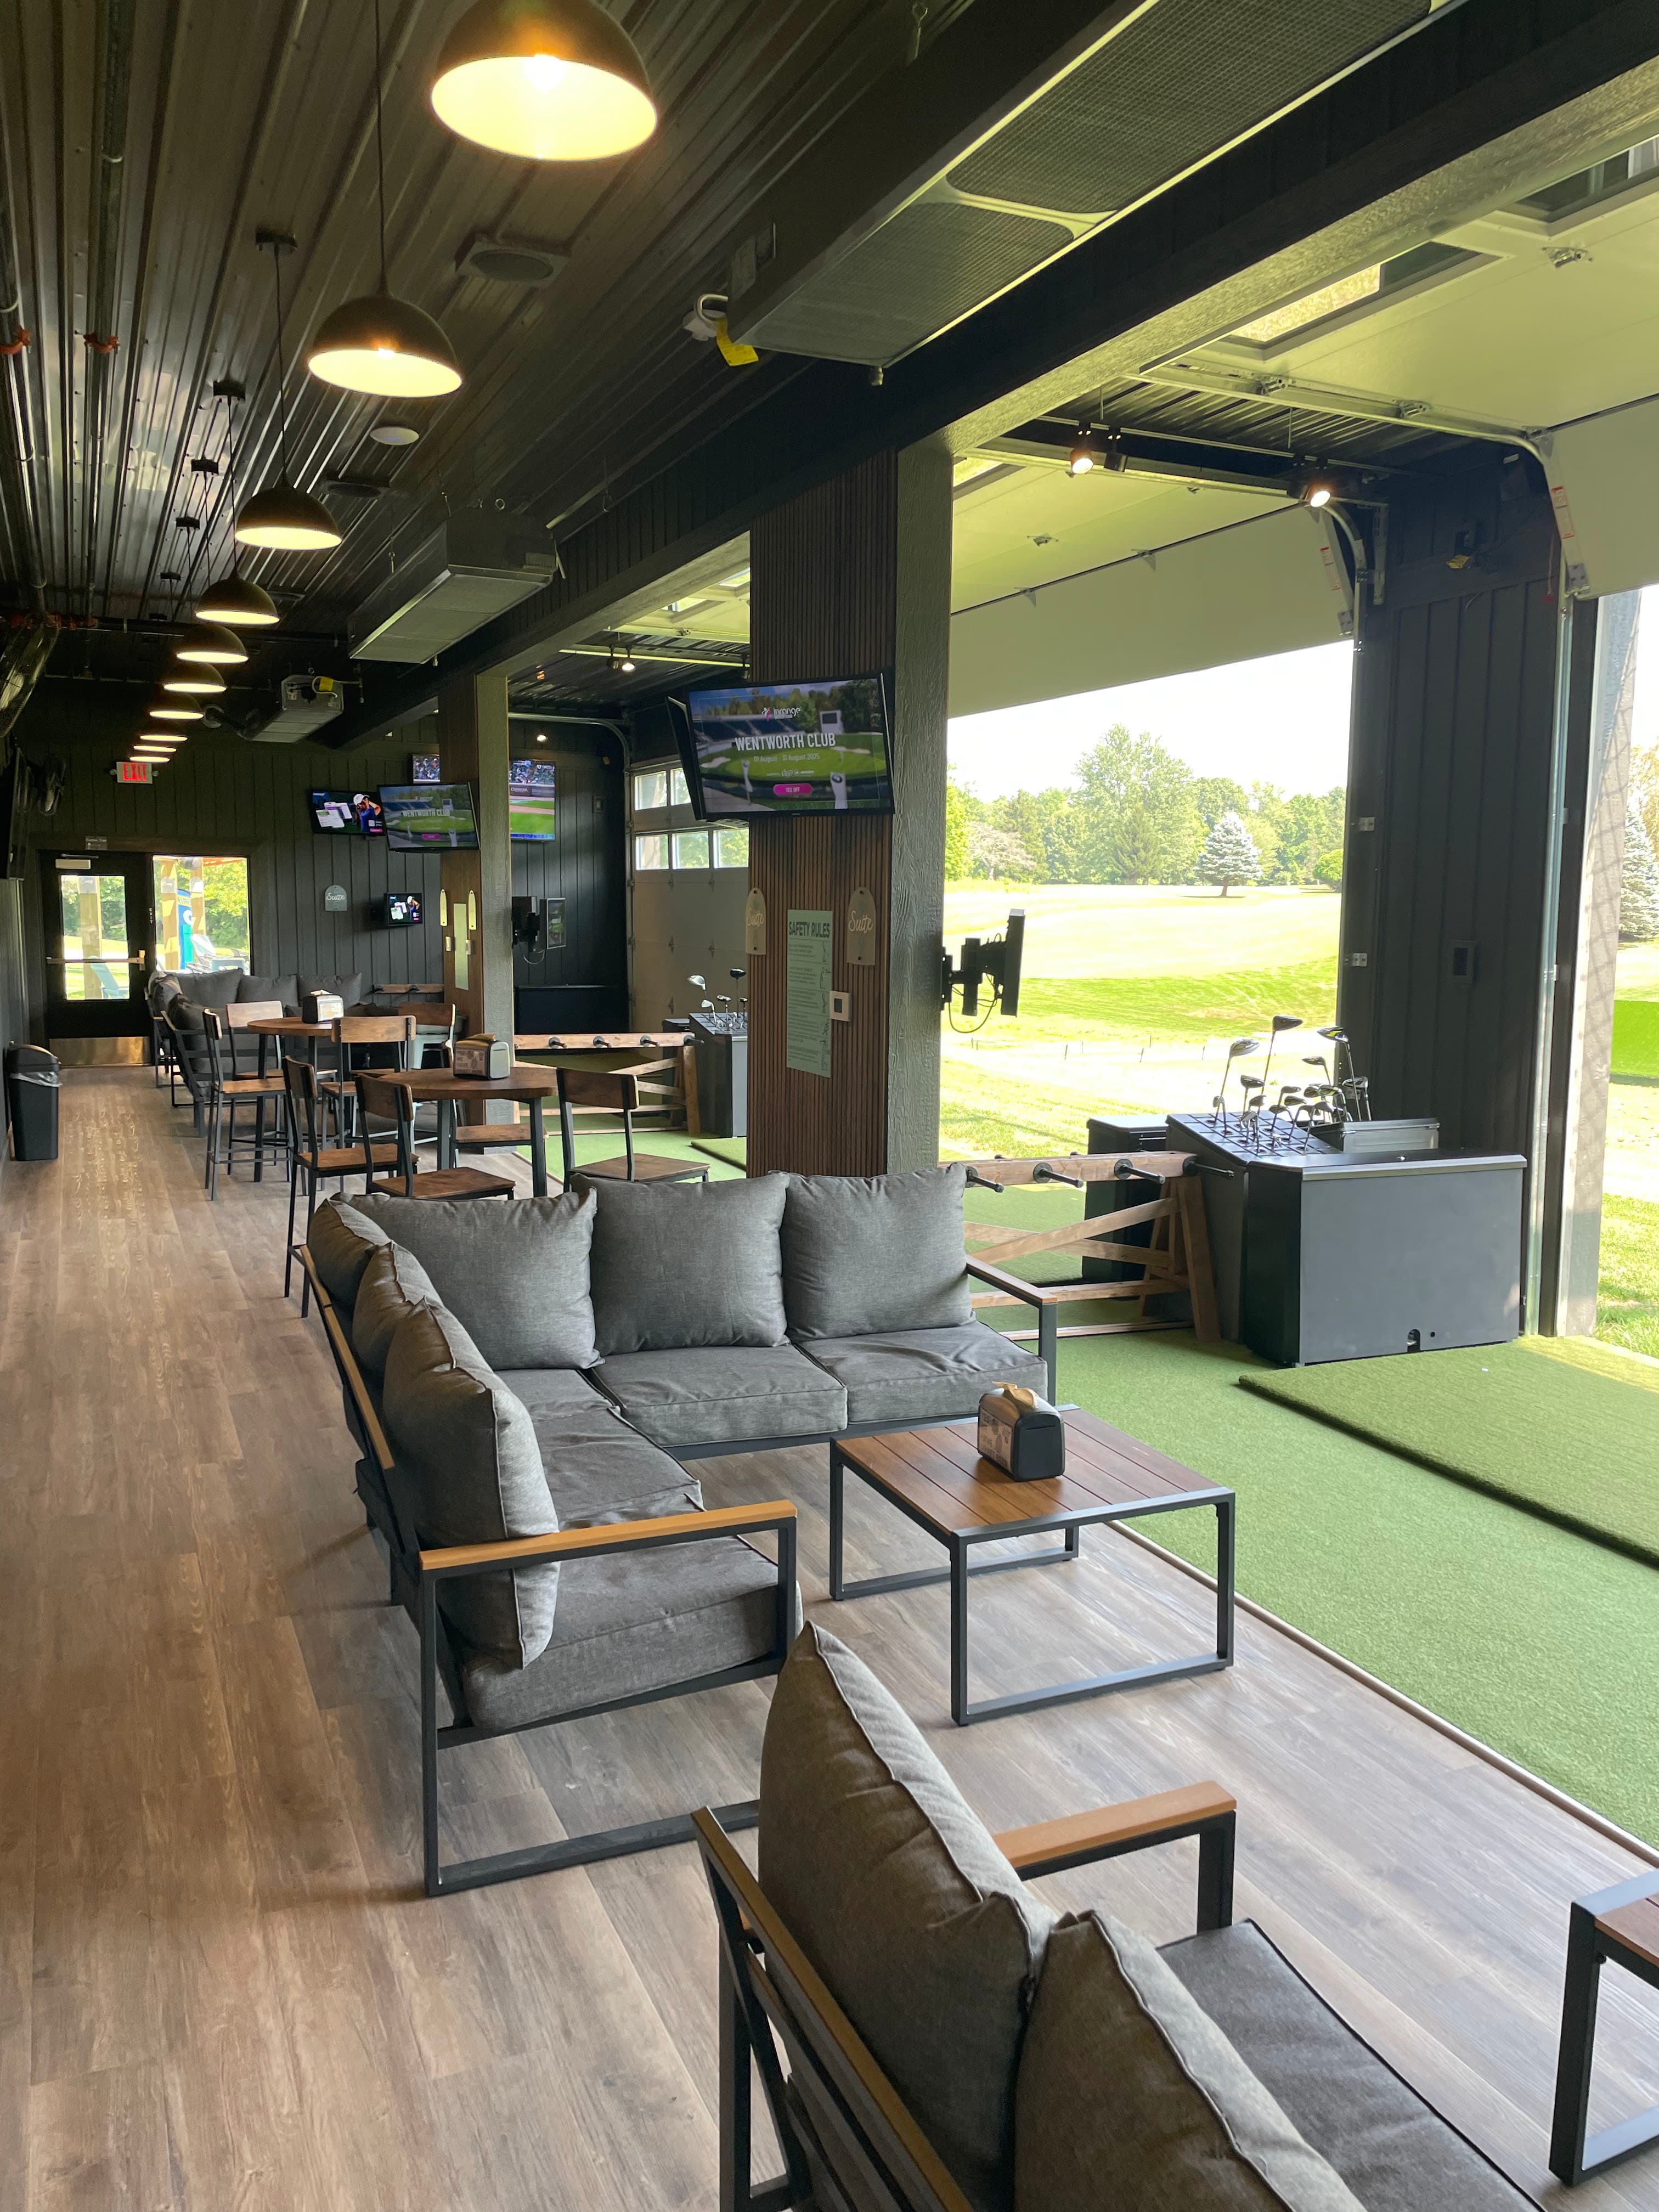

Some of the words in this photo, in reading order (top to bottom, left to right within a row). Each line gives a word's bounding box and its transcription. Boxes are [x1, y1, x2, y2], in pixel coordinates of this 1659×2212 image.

[735, 734, 804, 751] WENTWORTH
[808, 733, 836, 747] CLUB
[123, 763, 146, 782] EXIT
[747, 907, 764, 927] Suite
[848, 911, 873, 934] Suite
[789, 921, 809, 936] SAFETY
[811, 922, 830, 939] RULES
